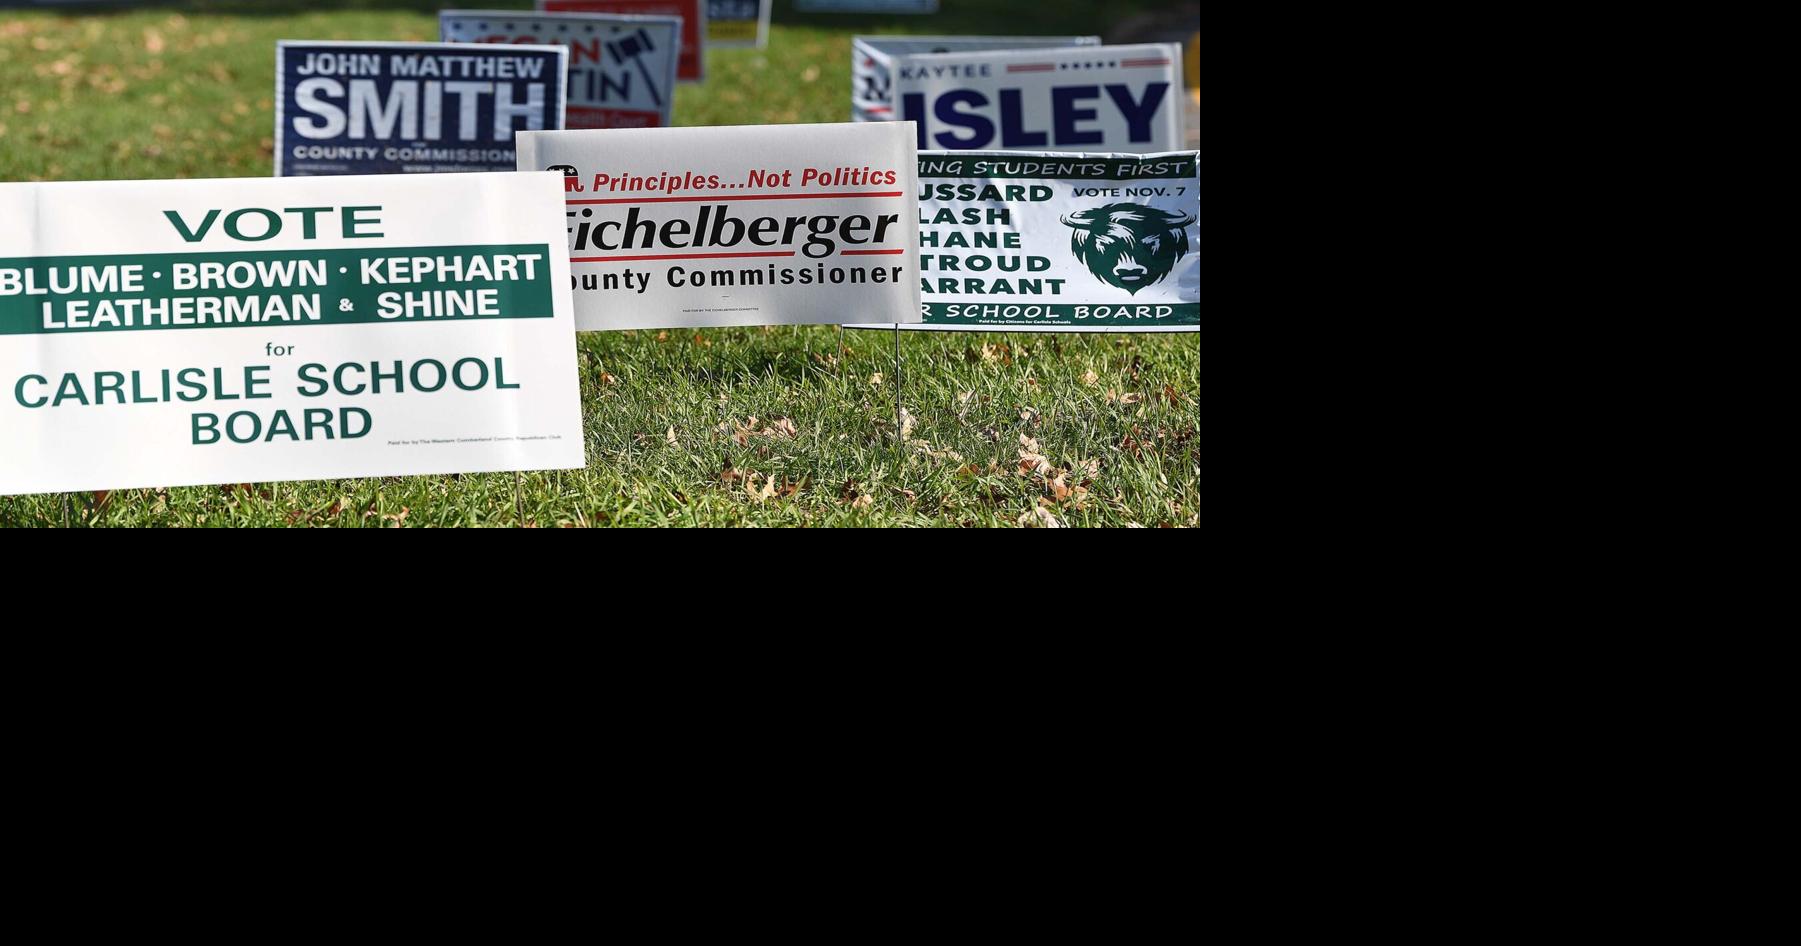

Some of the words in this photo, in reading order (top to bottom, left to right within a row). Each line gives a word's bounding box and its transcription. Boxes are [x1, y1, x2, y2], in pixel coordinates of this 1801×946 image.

[296, 54, 380, 77] JOHN
[391, 56, 544, 79] MATTHEW
[899, 64, 990, 80] KAYTEE
[293, 78, 544, 141] SMITH
[902, 82, 1169, 151] ISLEY
[293, 145, 377, 160] COUNTY
[383, 146, 516, 162] COMMISSION
[800, 167, 896, 187] Politics
[917, 160, 963, 174] ING
[973, 161, 1106, 175] STUDENTS
[1116, 161, 1188, 176] FIRST
[919, 183, 1054, 202] USSARD
[1073, 186, 1120, 198] VOTE
[1125, 186, 1172, 198] NOV.
[1175, 186, 1187, 197] 7
[163, 205, 385, 243] VOTE
[918, 207, 1011, 226] LASH
[919, 231, 1022, 249] HANE
[920, 254, 1051, 273] TROUD
[0, 265, 145, 296] BLUME
[173, 259, 328, 290] BROWN
[360, 254, 542, 285] KEPHART
[667, 263, 903, 287] Commissioner
[42, 294, 321, 329] LEATHERMAN
[338, 298, 354, 312] &
[377, 289, 499, 319] SHINE
[946, 304, 1060, 319] SCHOOL
[1074, 306, 1174, 320] BOARD
[265, 342, 295, 357] for
[14, 365, 273, 408] CARLISLE
[296, 357, 520, 397] SCHOOL
[191, 406, 373, 445] BOARD
